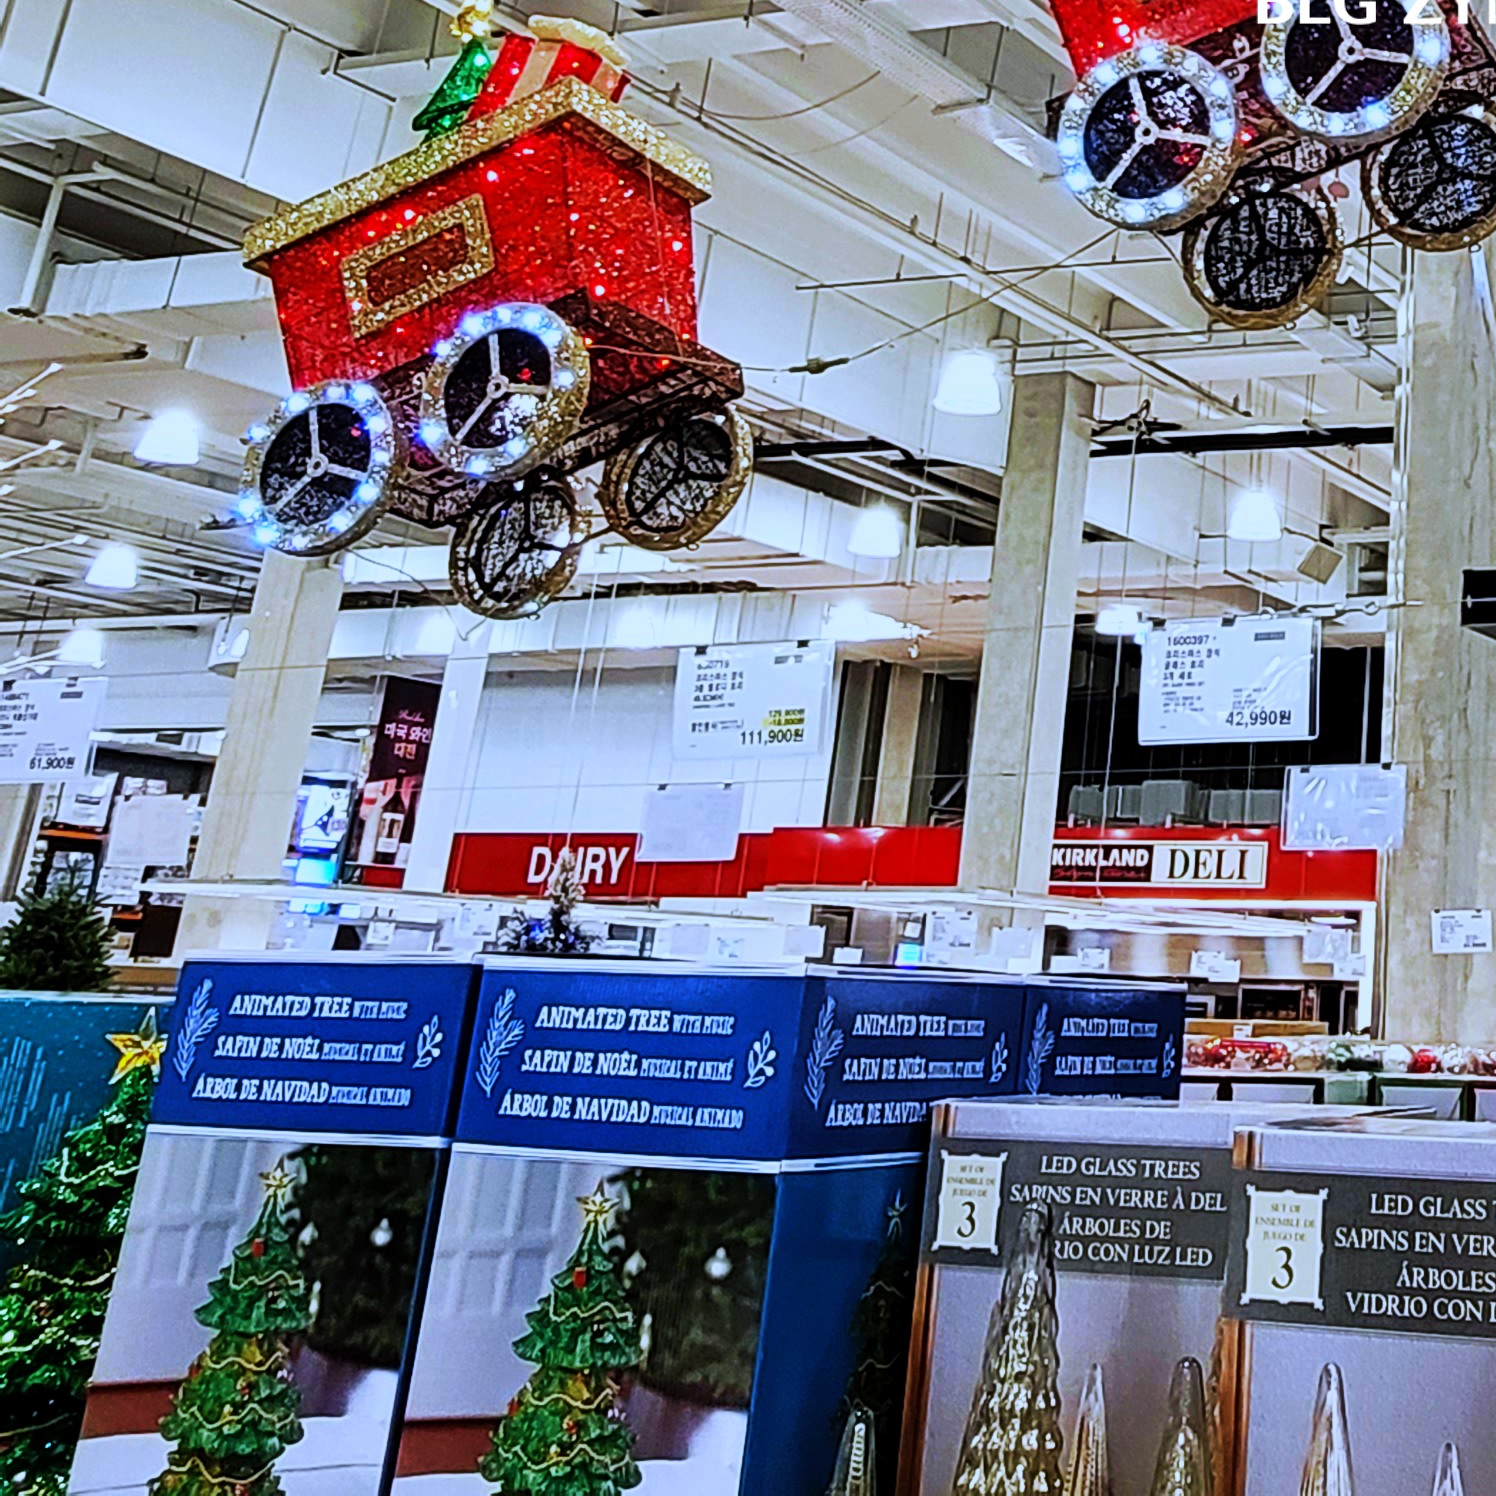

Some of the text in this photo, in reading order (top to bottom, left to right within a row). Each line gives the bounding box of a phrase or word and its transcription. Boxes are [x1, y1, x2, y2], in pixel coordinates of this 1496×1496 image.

[1226, 710, 1291, 728] 42,990원
[740, 728, 805, 745] 111,900원
[1051, 848, 1149, 867] KIRKLAND
[1168, 848, 1249, 880] DELI
[229, 995, 311, 1017] ANIMATED
[312, 996, 352, 1017] TREE
[534, 1006, 626, 1031] ANIMATED
[628, 1009, 671, 1032] TREE
[260, 1037, 280, 1058] DE
[573, 1052, 593, 1074] DE
[192, 1073, 239, 1099] ÁRBOL
[239, 1079, 259, 1100] DE
[259, 1080, 329, 1103] NAVIDAD
[499, 1088, 549, 1117] ÁRBOL
[550, 1095, 572, 1119] DE
[573, 1097, 650, 1123] NAVIDAD
[1040, 1155, 1200, 1179] LED GLASS TREES
[1075, 1187, 1101, 1206] EN
[1106, 1188, 1168, 1209] VERRE
[1172, 1185, 1184, 1211] À
[1190, 1191, 1227, 1212] DEL
[1370, 1193, 1413, 1216] LED
[1419, 1196, 1487, 1220] GLASS
[957, 1201, 976, 1238] 3
[1058, 1211, 1171, 1240] ÁRBOLES DE
[1334, 1227, 1409, 1251] SAPINS
[1414, 1231, 1445, 1253] EN
[1087, 1242, 1129, 1262] CON
[1134, 1244, 1170, 1265] LUZ
[1175, 1247, 1213, 1267] LED
[1271, 1245, 1294, 1289] 3
[1396, 1260, 1496, 1293] ÁRBOLES
[1345, 1292, 1427, 1317] VIDRIO
[1432, 1297, 1484, 1322] CON
